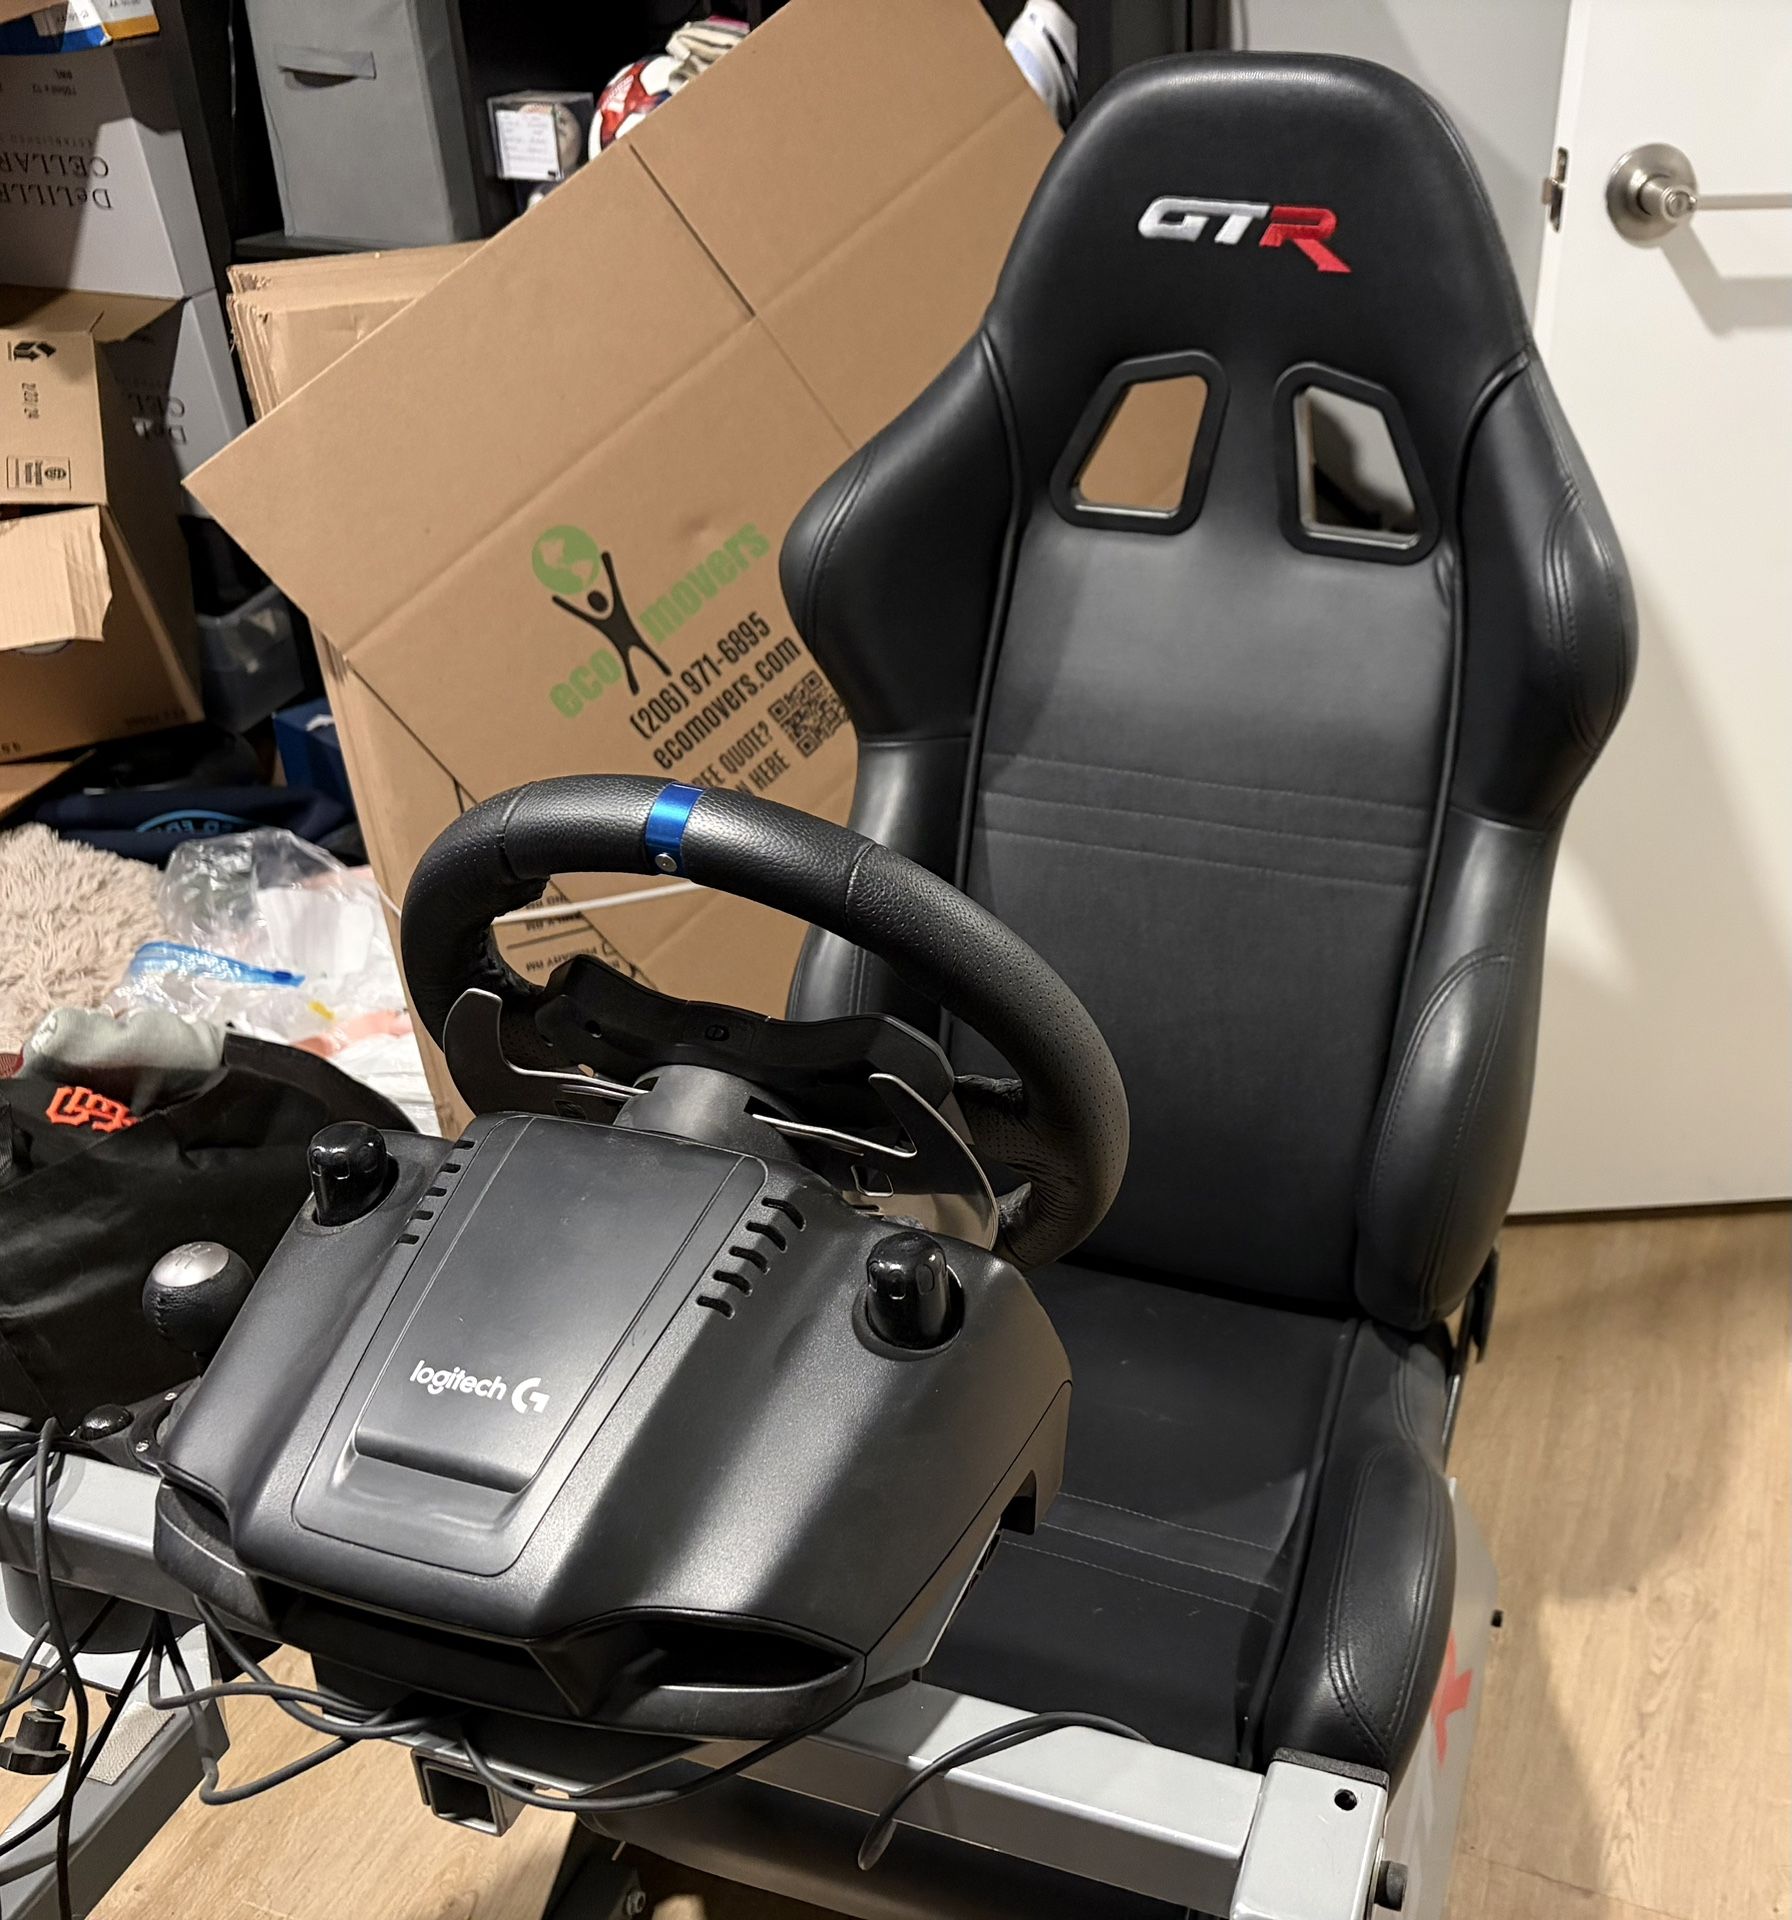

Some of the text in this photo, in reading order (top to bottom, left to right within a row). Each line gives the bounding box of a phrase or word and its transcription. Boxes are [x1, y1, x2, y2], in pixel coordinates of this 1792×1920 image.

[1138, 196, 1352, 273] GTR
[550, 522, 770, 718] eco movers
[629, 611, 771, 740] (206) 971-6895
[653, 636, 801, 770] ecomovers.com
[719, 720, 773, 774] QUOTE?
[748, 749, 790, 791] HERE
[409, 1360, 550, 1414] logitech G
